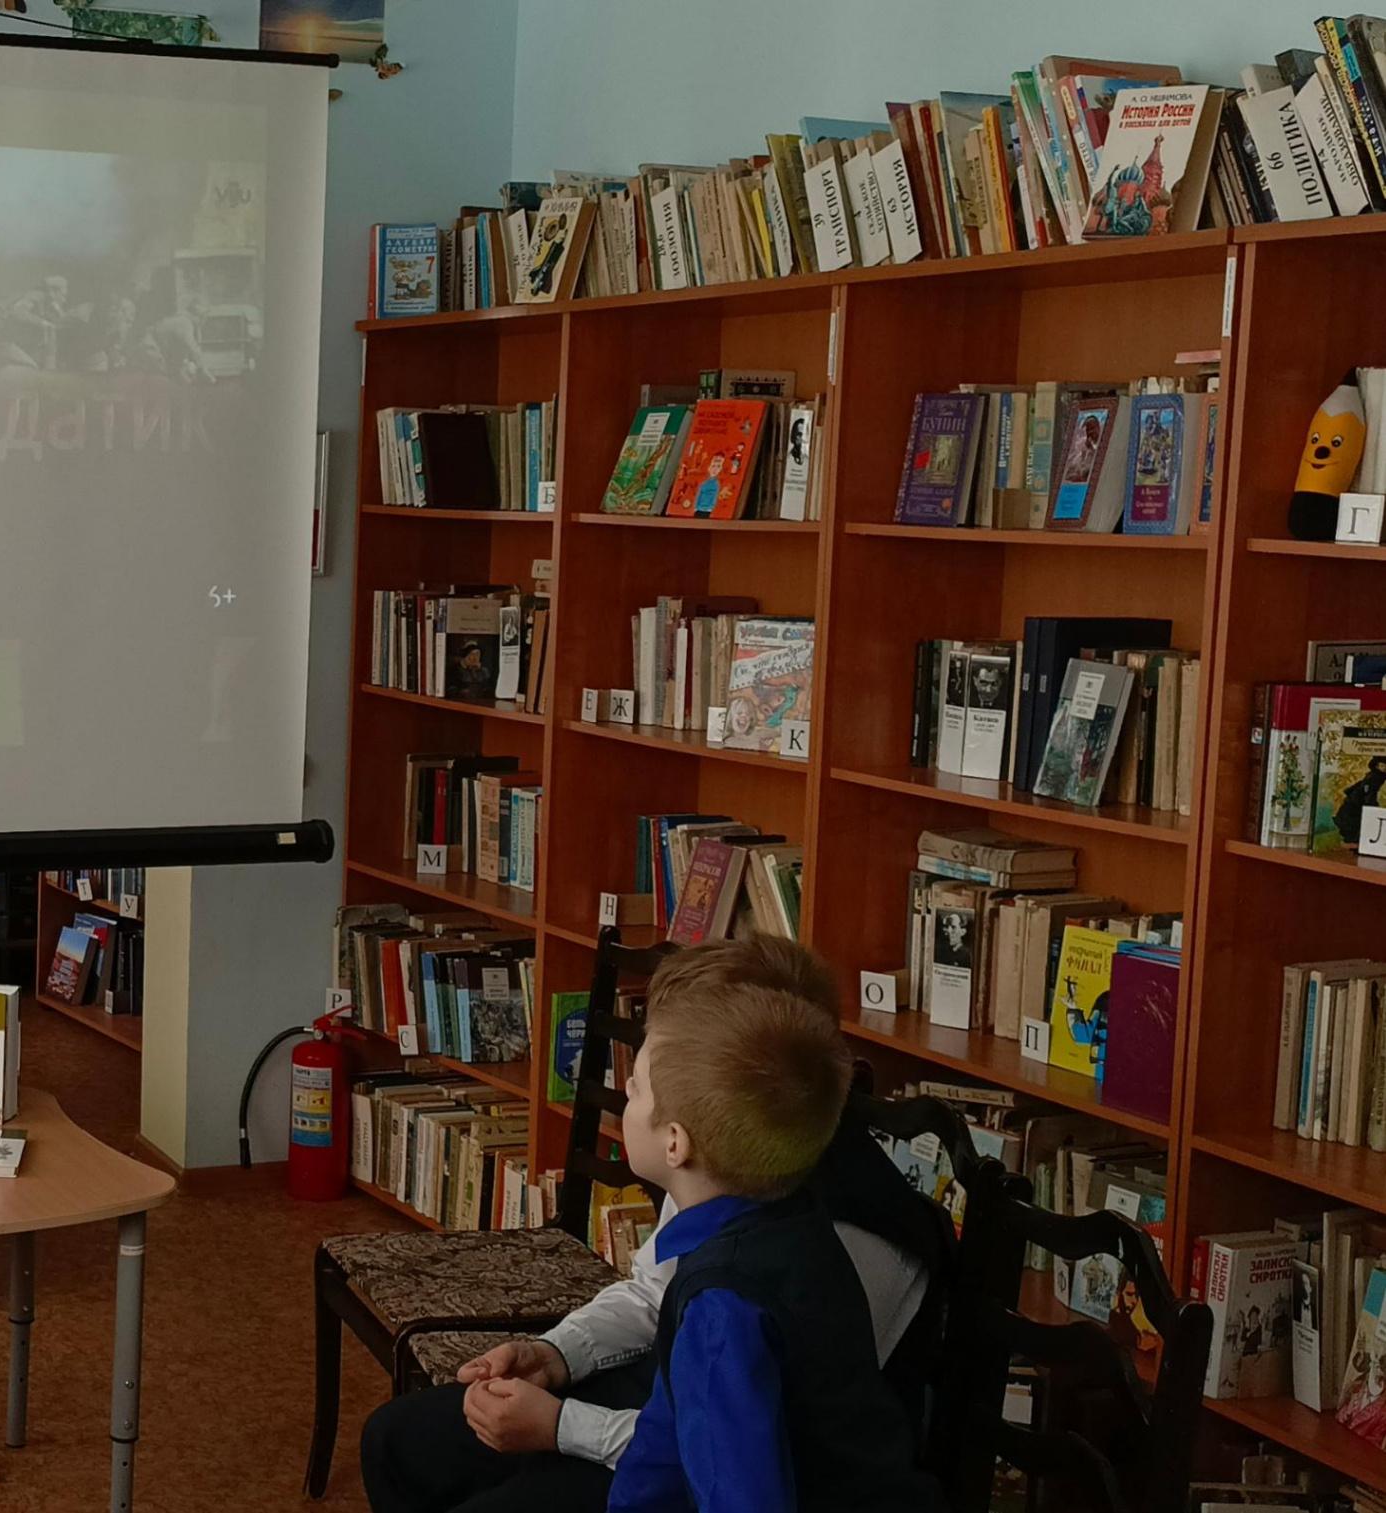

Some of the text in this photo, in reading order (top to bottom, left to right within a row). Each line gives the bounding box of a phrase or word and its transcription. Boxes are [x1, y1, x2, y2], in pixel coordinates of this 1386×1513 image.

[1317, 114, 1348, 183] НАРОДНОЕ
[1319, 93, 1359, 187] ОБРАЗОВАНИЕ
[1267, 151, 1285, 171] 66
[1278, 101, 1324, 206] ПОЛИТИКА
[858, 180, 876, 236] СЕЛЬСКОЕ
[866, 170, 886, 233] ХОЗЯЙСТВО
[887, 197, 898, 213] 63
[892, 158, 917, 236] ИСТОРИЯ
[814, 212, 826, 229] 39
[820, 168, 846, 258] ТРАНСПОРТ
[662, 201, 681, 279] ЗООЛОГИЯ
[426, 256, 435, 274] 7
[921, 417, 967, 432] БУНИН
[1346, 506, 1370, 534] Г
[613, 695, 630, 718] Ж
[788, 728, 806, 751] К
[421, 849, 442, 868] М
[124, 897, 136, 912] У
[604, 893, 615, 916] Н
[1066, 956, 1103, 976] ФИНАЛ
[331, 993, 343, 1011] Р
[865, 982, 884, 1004] О
[400, 1031, 410, 1049] С
[1024, 1024, 1040, 1052] П
